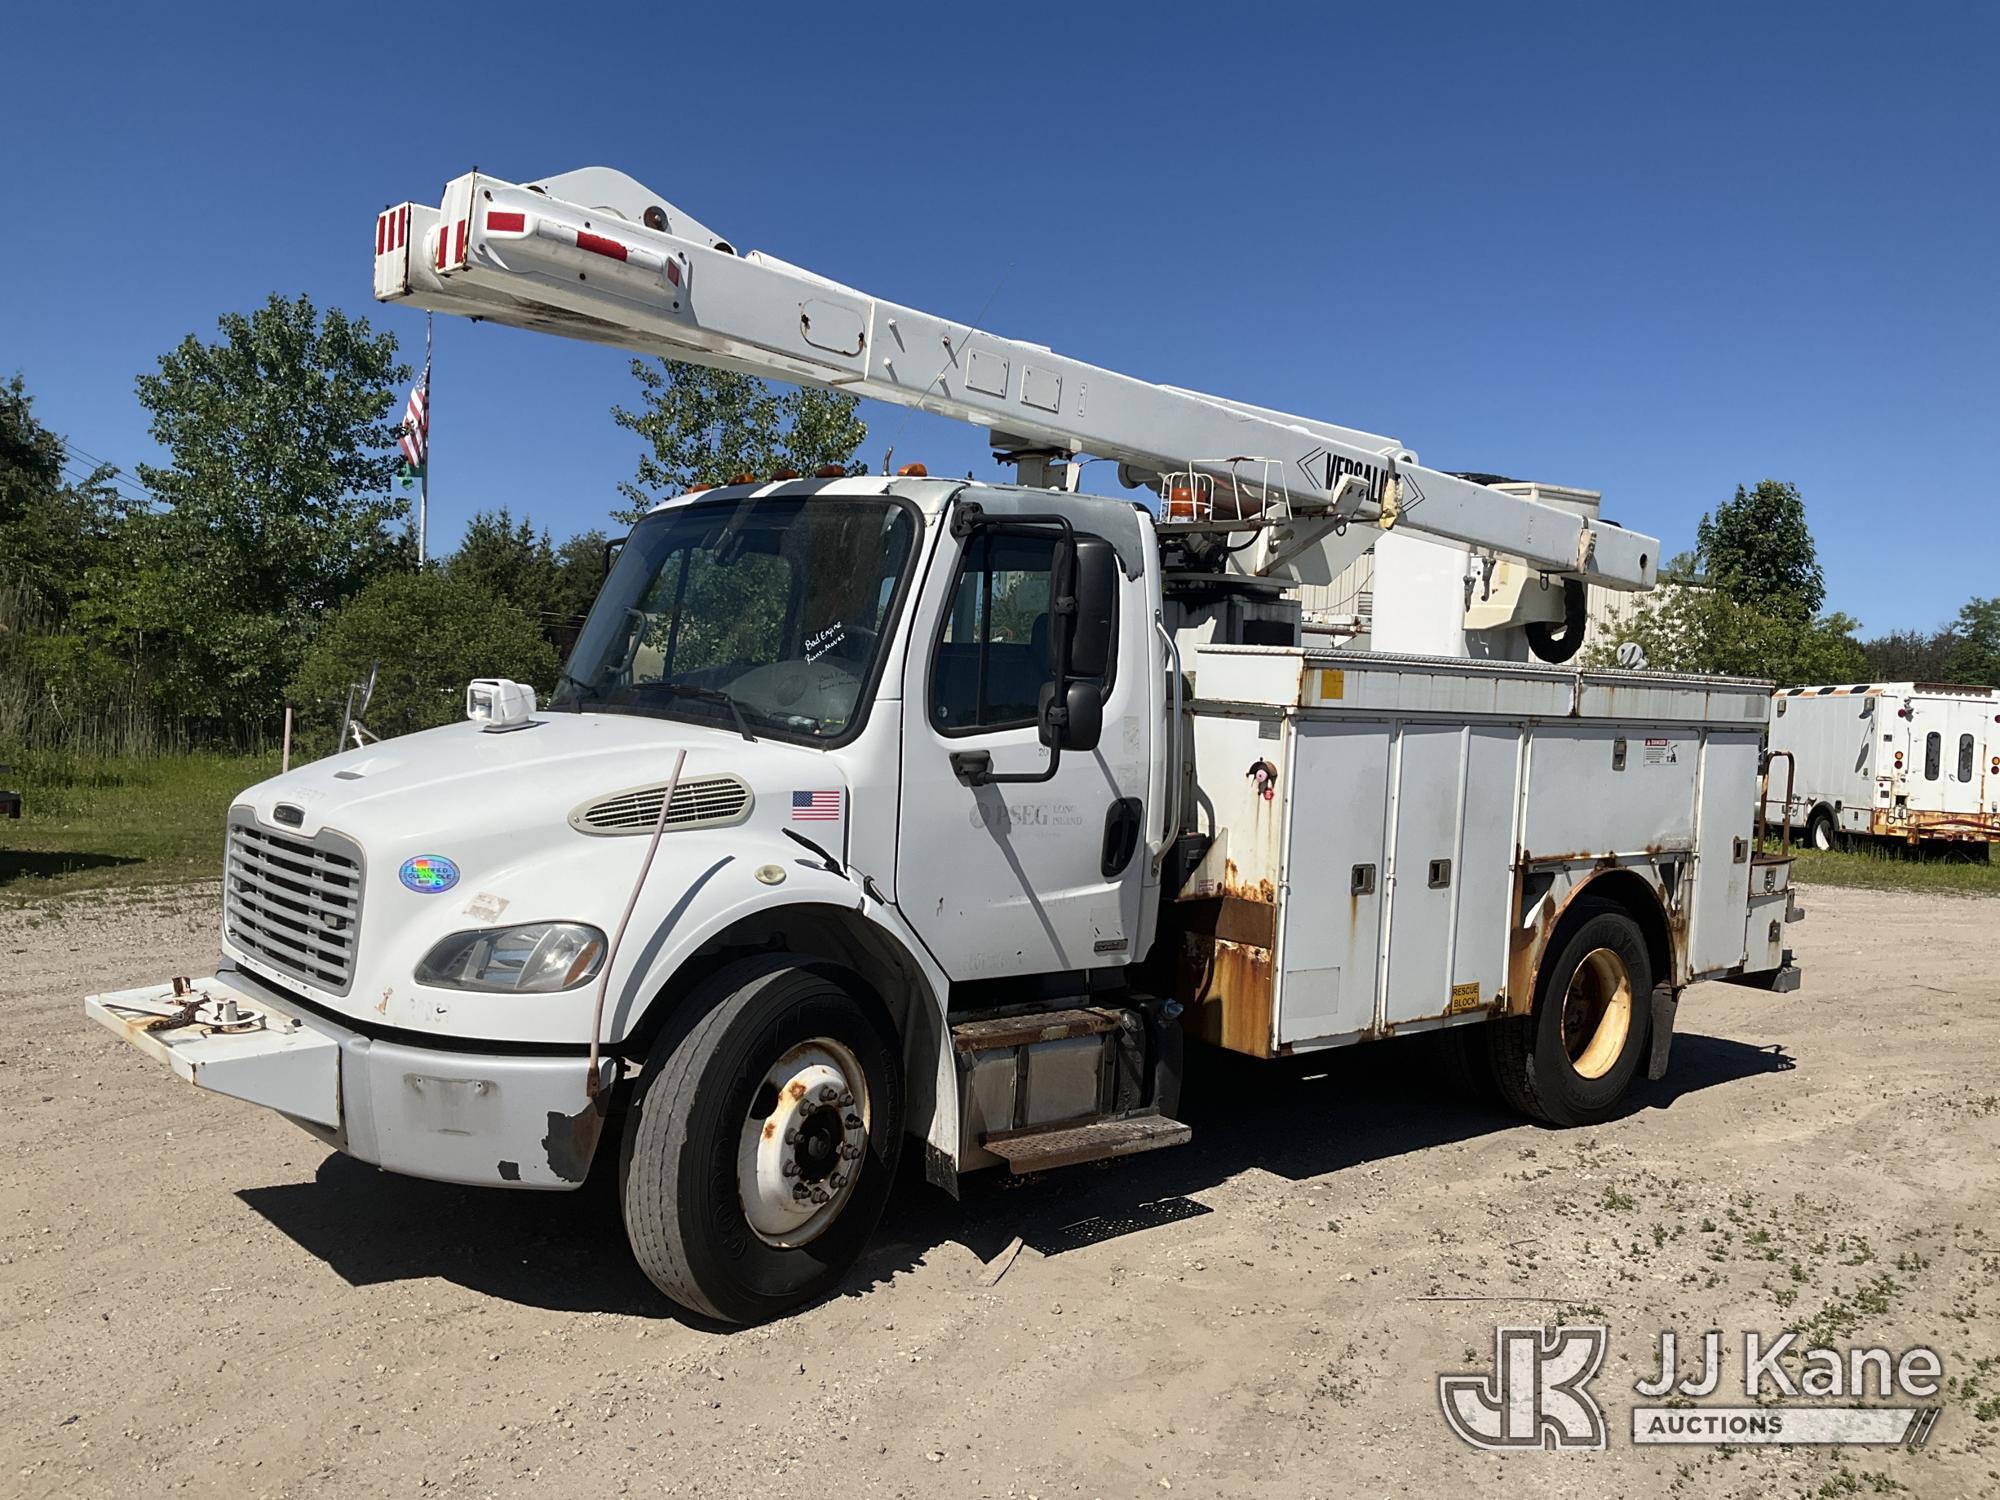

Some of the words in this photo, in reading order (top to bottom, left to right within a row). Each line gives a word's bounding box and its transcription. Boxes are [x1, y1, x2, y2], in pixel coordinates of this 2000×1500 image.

[1325, 452, 1401, 504] VEALI
[804, 633, 821, 651] Bad
[1453, 985, 1478, 996] RESCUE
[1454, 997, 1476, 1008] BLOCK
